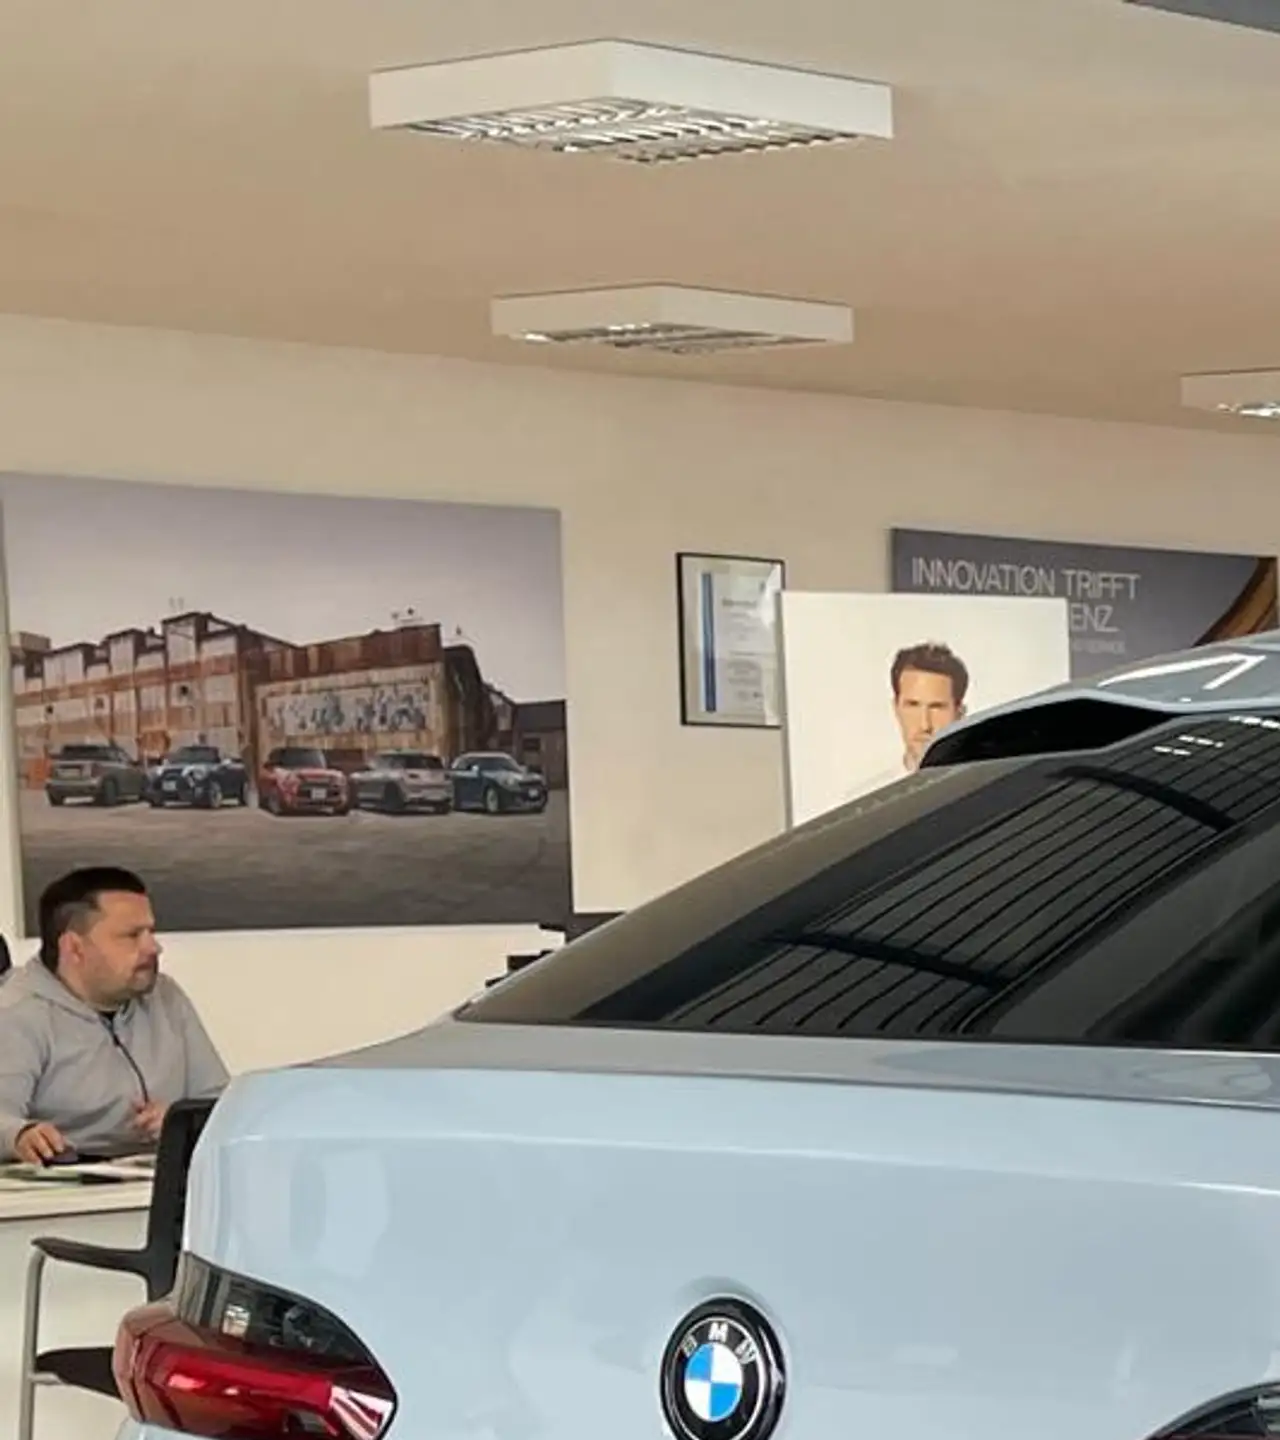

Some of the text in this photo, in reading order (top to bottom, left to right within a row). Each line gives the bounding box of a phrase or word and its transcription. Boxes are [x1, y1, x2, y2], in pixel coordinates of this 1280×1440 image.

[911, 557, 1141, 601] INNOVATION TRIFFT
[676, 1320, 758, 1366] BMW
